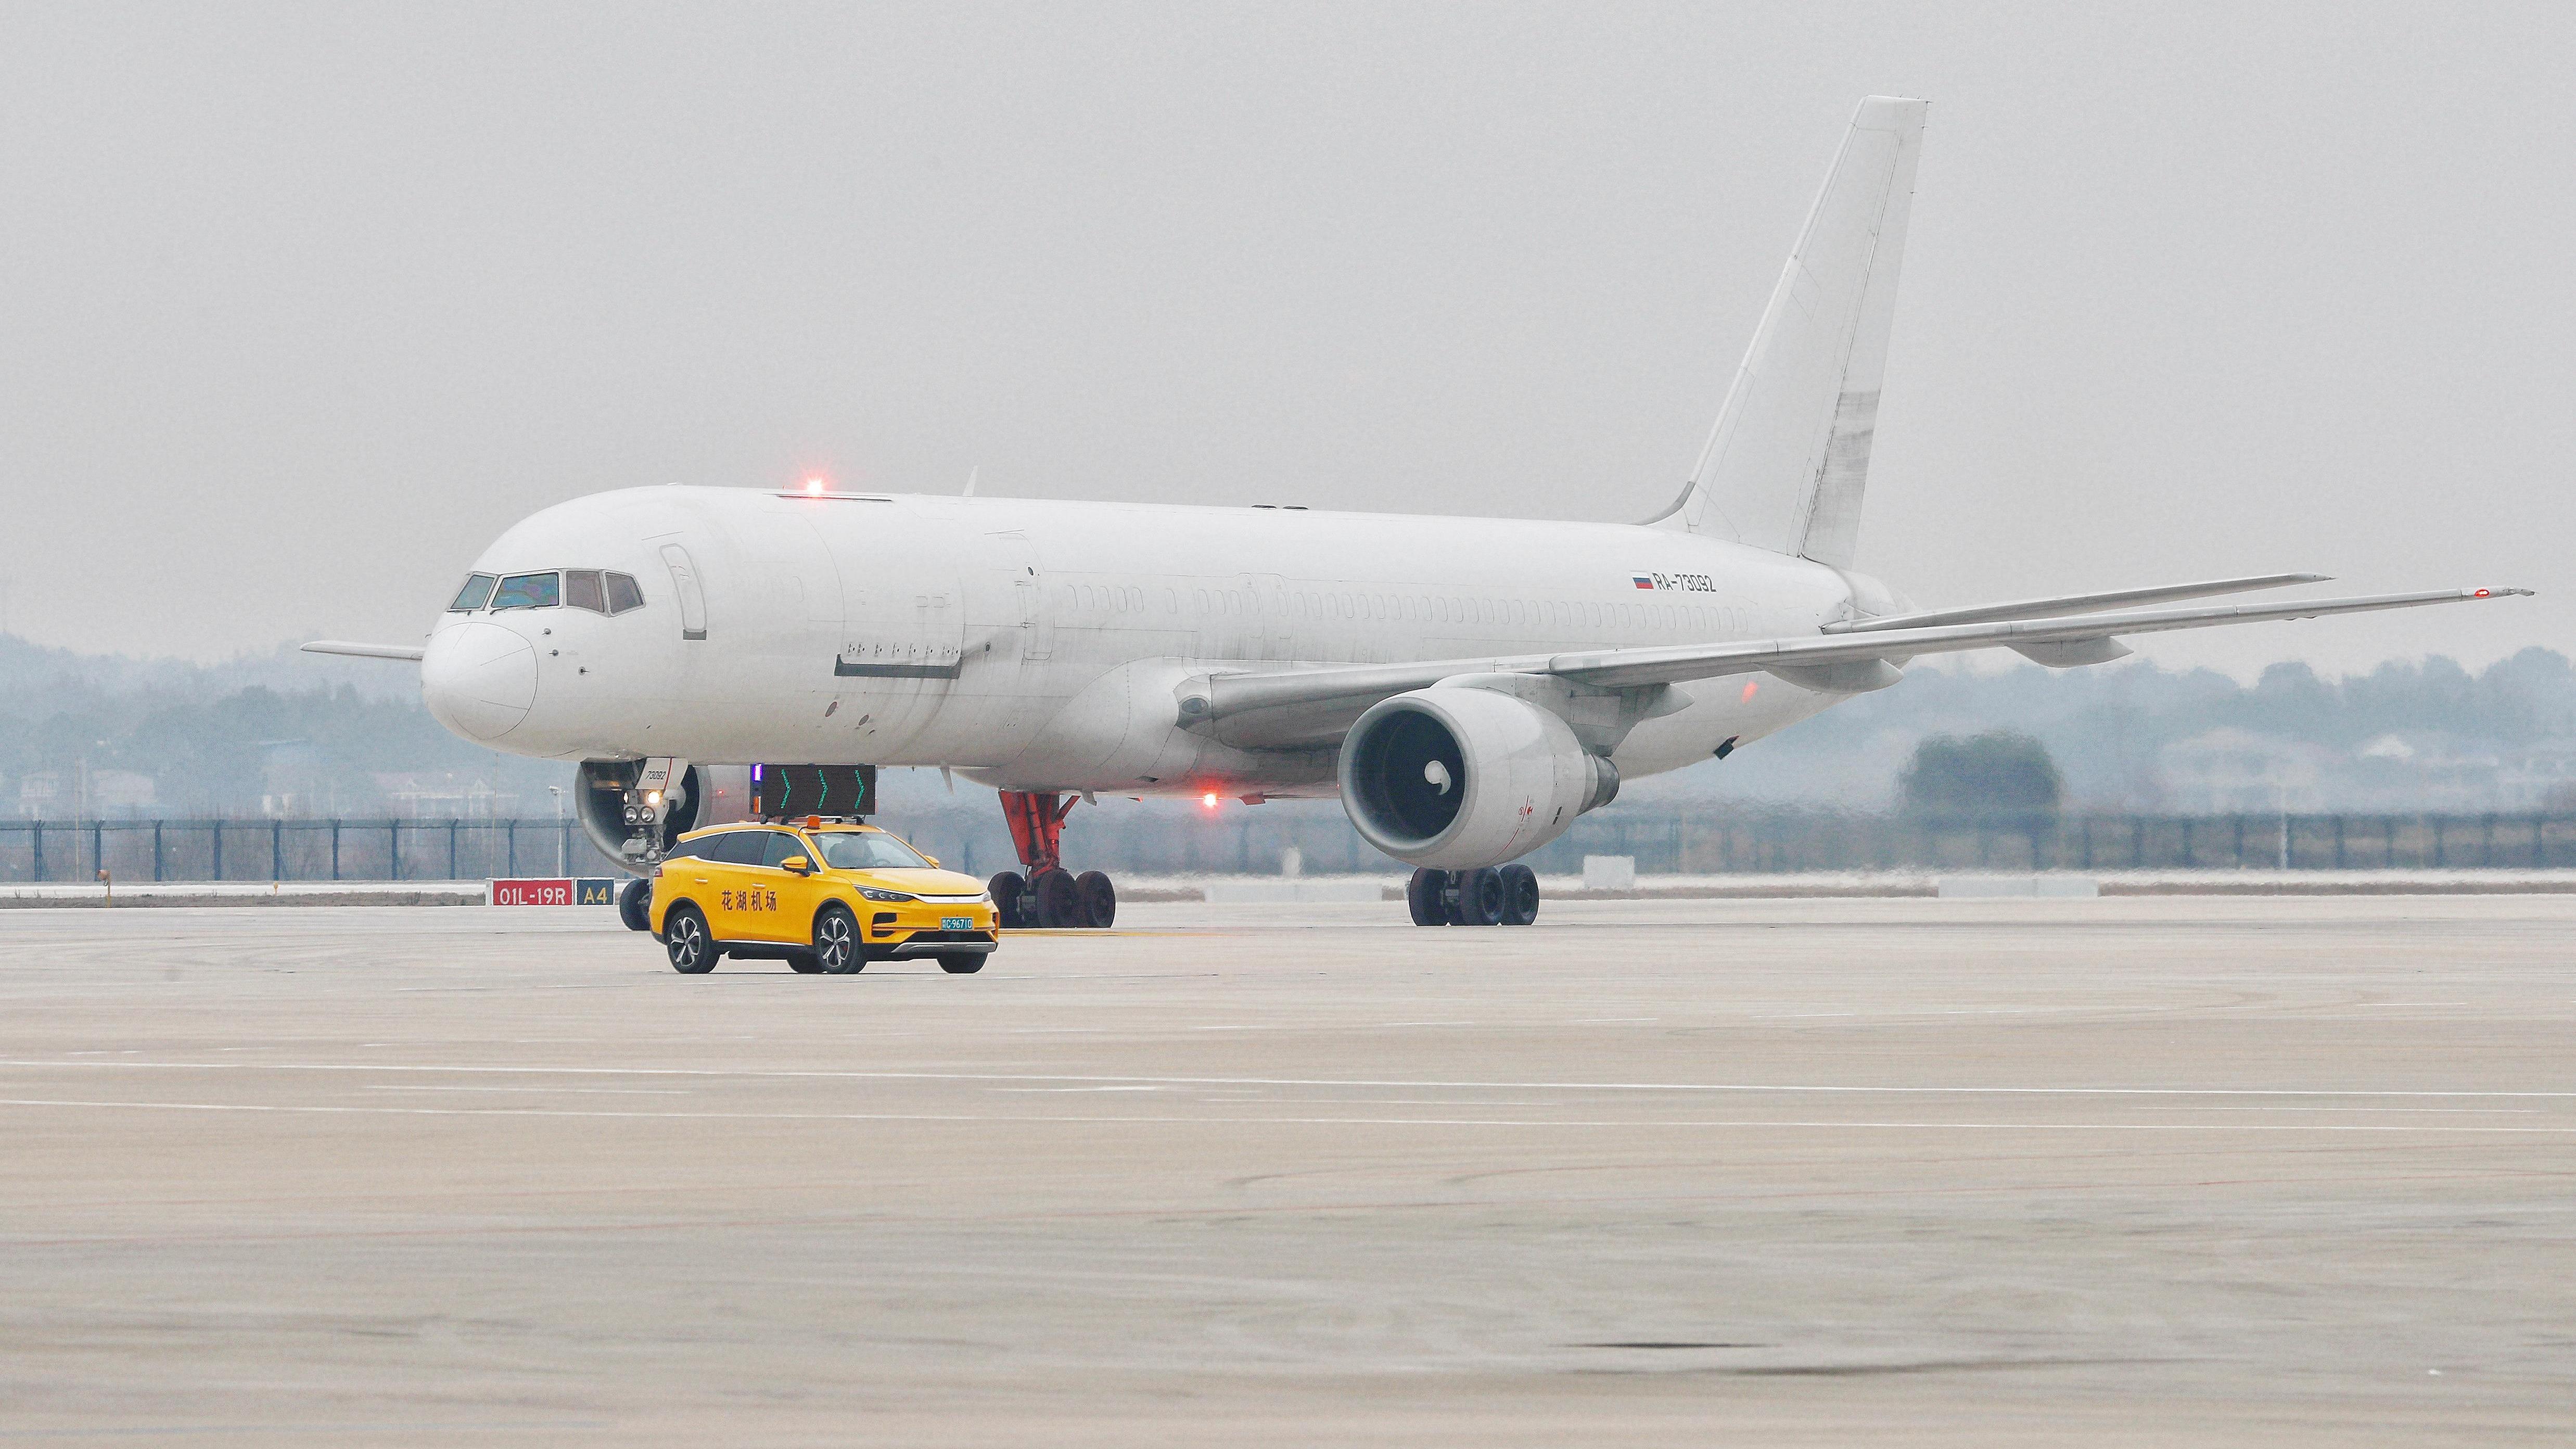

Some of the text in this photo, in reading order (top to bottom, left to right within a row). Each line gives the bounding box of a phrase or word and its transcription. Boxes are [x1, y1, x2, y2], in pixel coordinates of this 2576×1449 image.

[1652, 573, 1716, 592] RA-73092
[645, 771, 666, 780] 73092
[500, 887, 566, 905] 01L-19R
[583, 887, 608, 904] A4
[721, 889, 777, 911] 花湖机场
